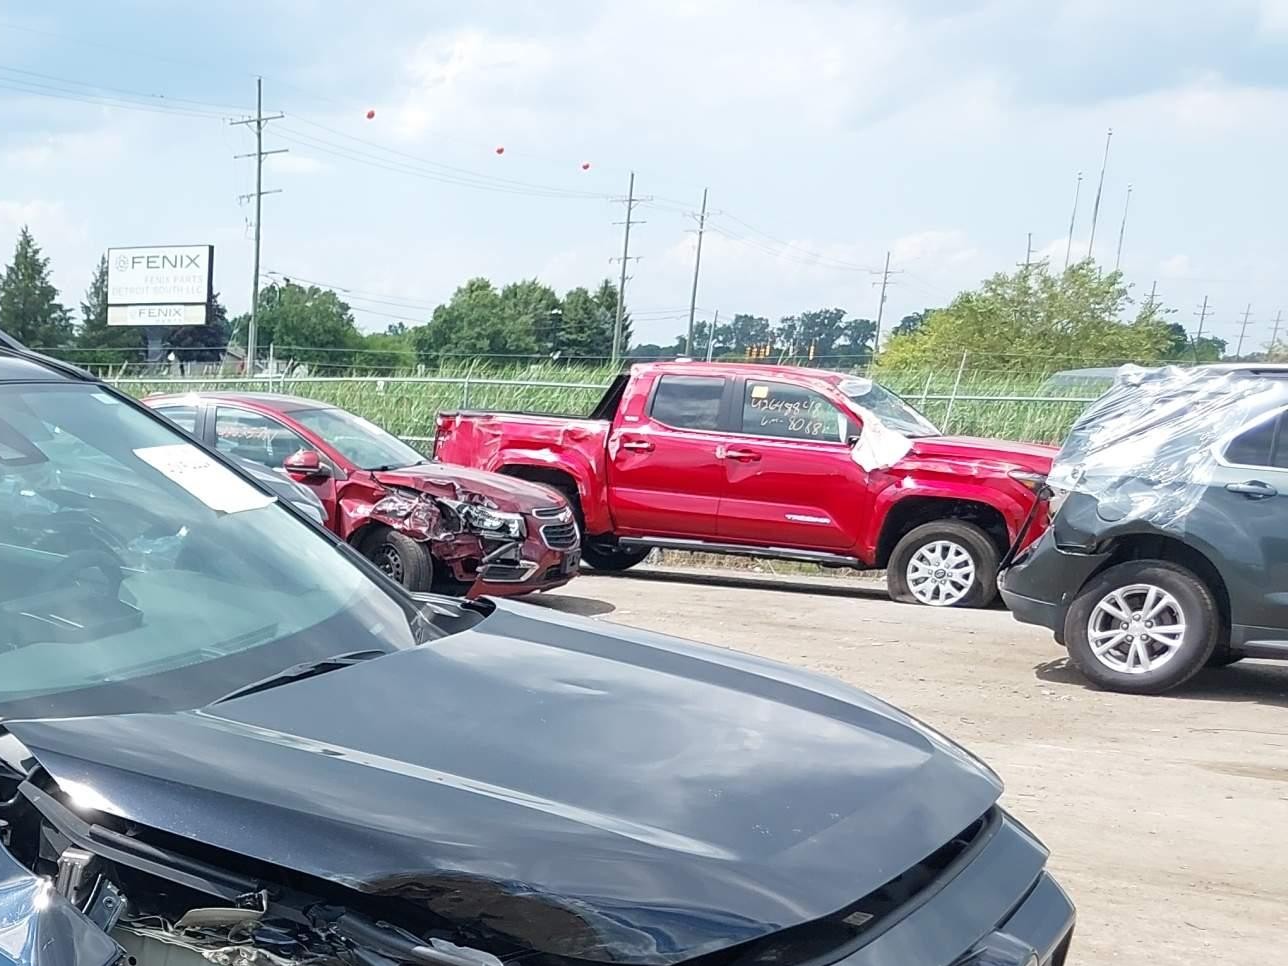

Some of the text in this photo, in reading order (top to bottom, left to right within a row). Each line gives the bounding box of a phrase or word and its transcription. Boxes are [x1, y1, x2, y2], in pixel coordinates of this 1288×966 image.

[131, 254, 201, 270] FENIX
[144, 274, 203, 284] FENIX PARTS
[112, 286, 150, 297] DETROIT
[138, 308, 182, 318] FENIX
